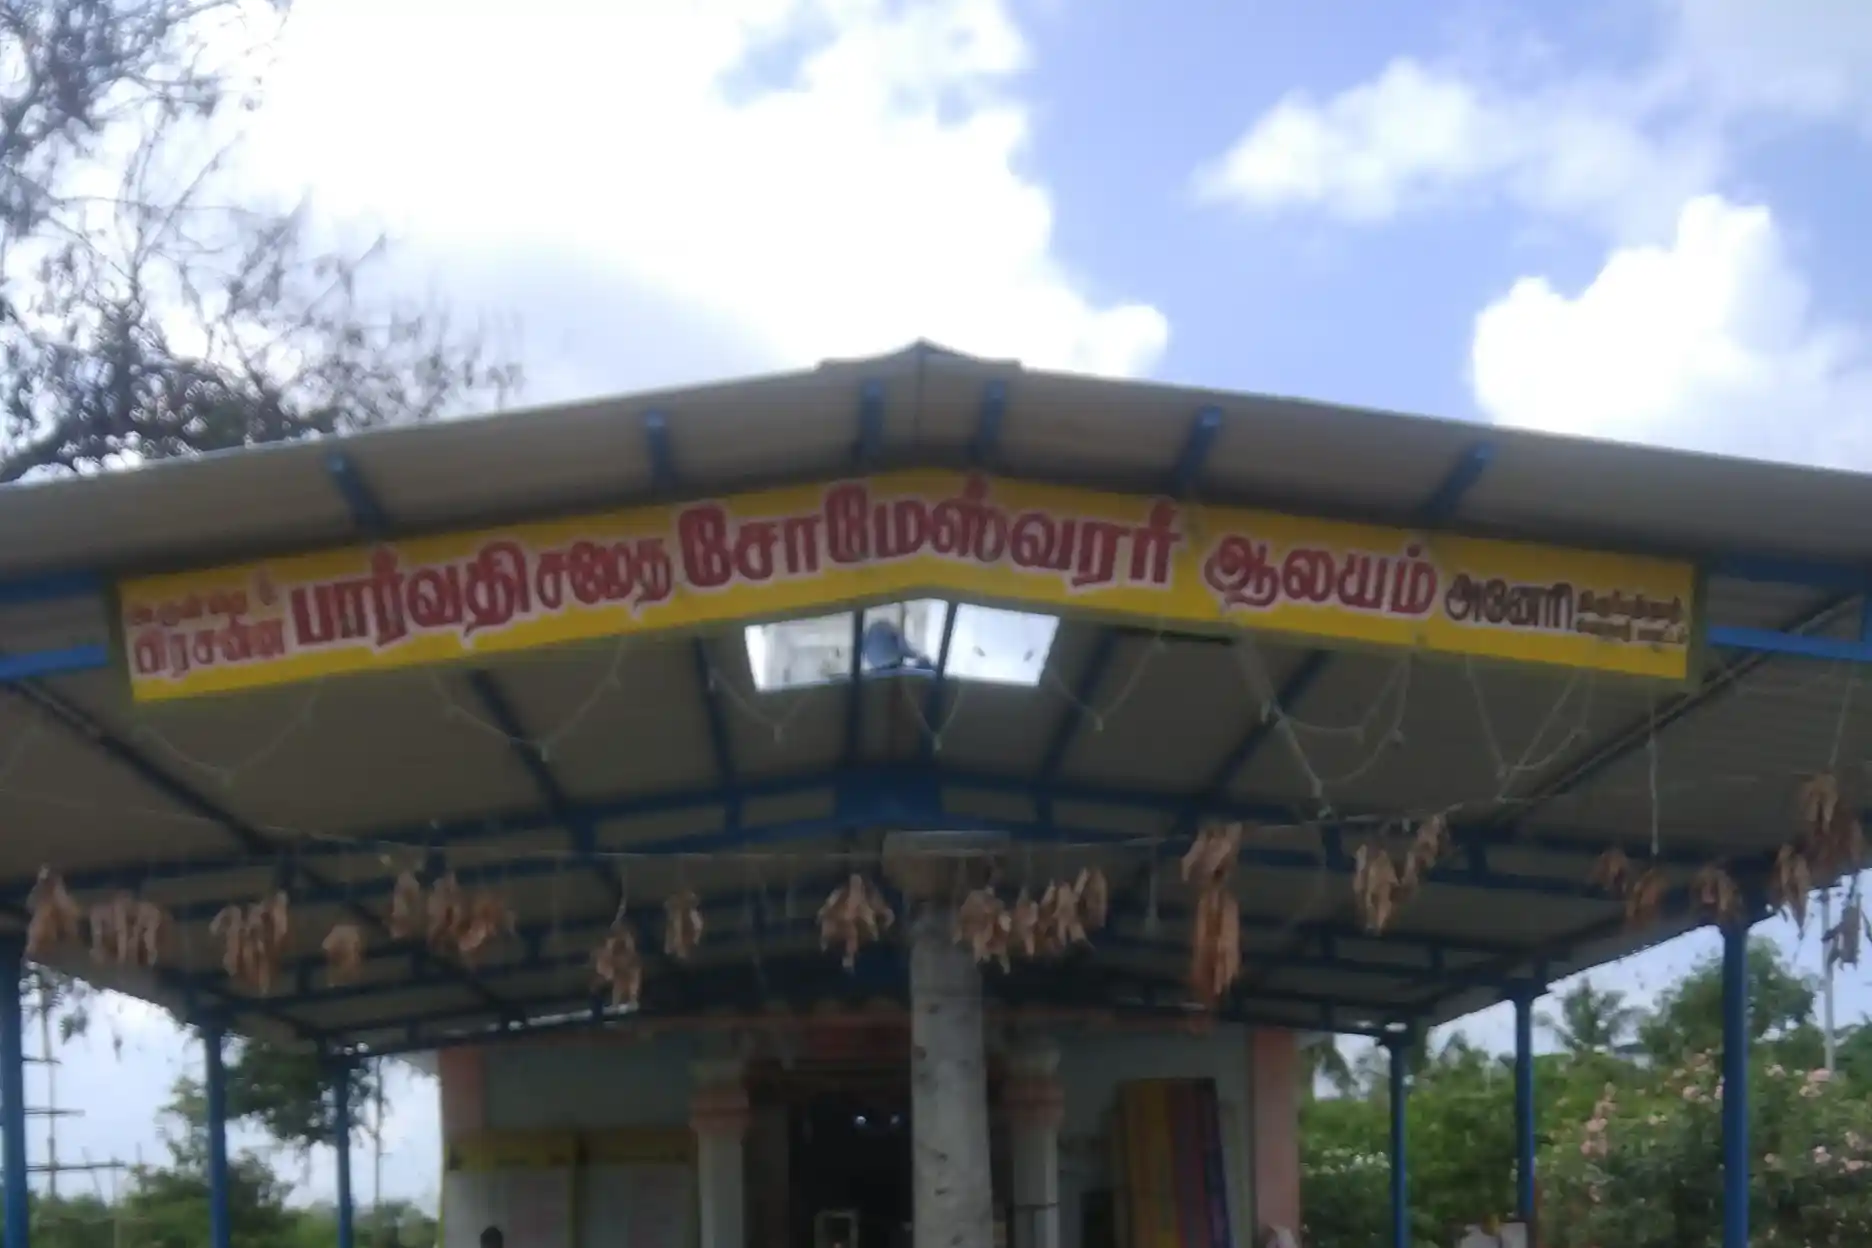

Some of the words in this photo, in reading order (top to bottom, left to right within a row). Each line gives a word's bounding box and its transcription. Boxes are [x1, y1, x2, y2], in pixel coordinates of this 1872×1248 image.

[292, 541, 529, 646] பார்வதி
[677, 474, 1184, 587] சோமேஸ்வரர்
[1203, 534, 1438, 614] ஆலயம்
